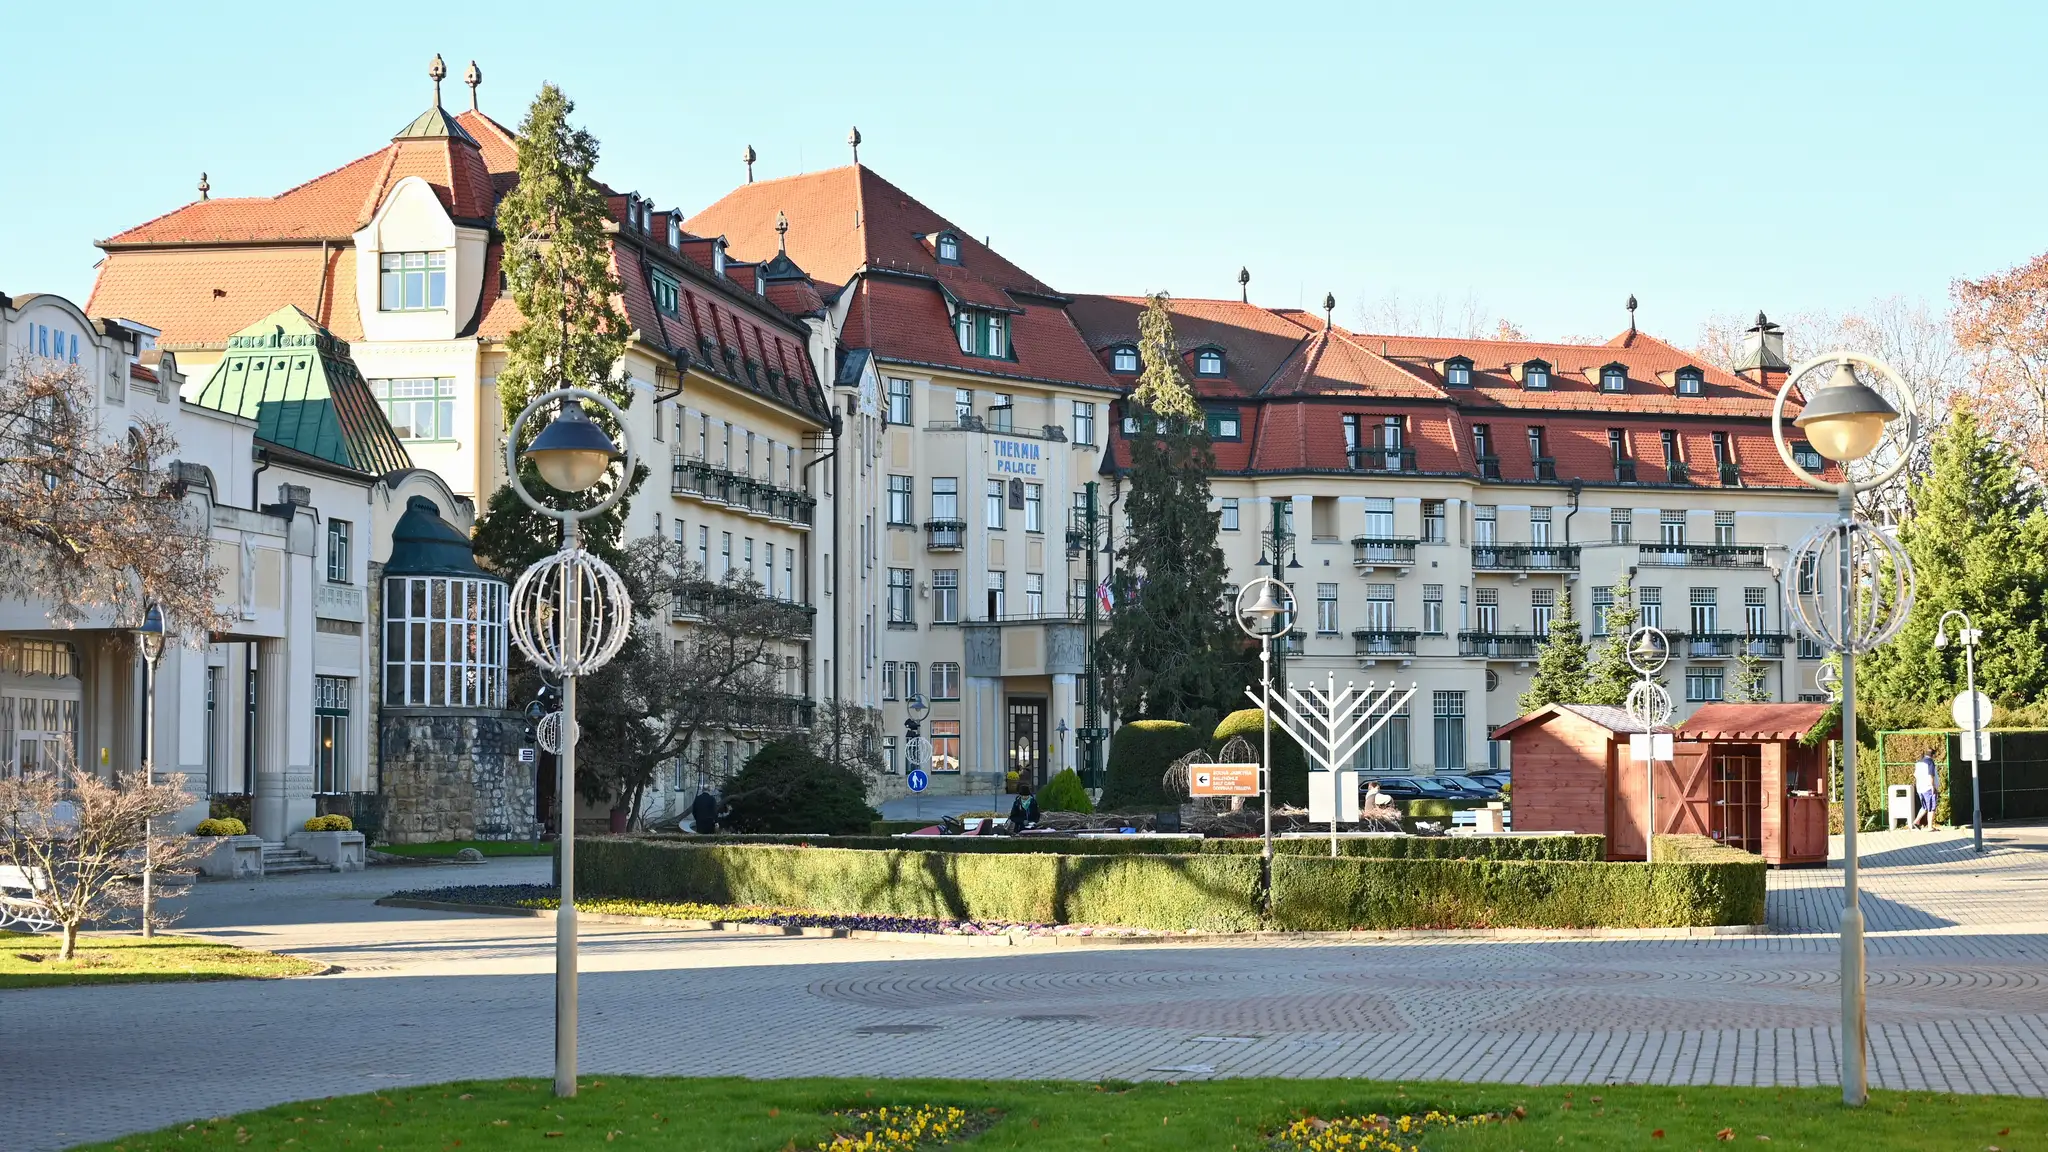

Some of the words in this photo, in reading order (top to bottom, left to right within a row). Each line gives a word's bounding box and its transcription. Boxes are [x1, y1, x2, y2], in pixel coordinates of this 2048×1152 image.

[29, 322, 79, 365] IRMA
[993, 440, 1040, 460] THERMIA
[997, 460, 1036, 475] PALACE
